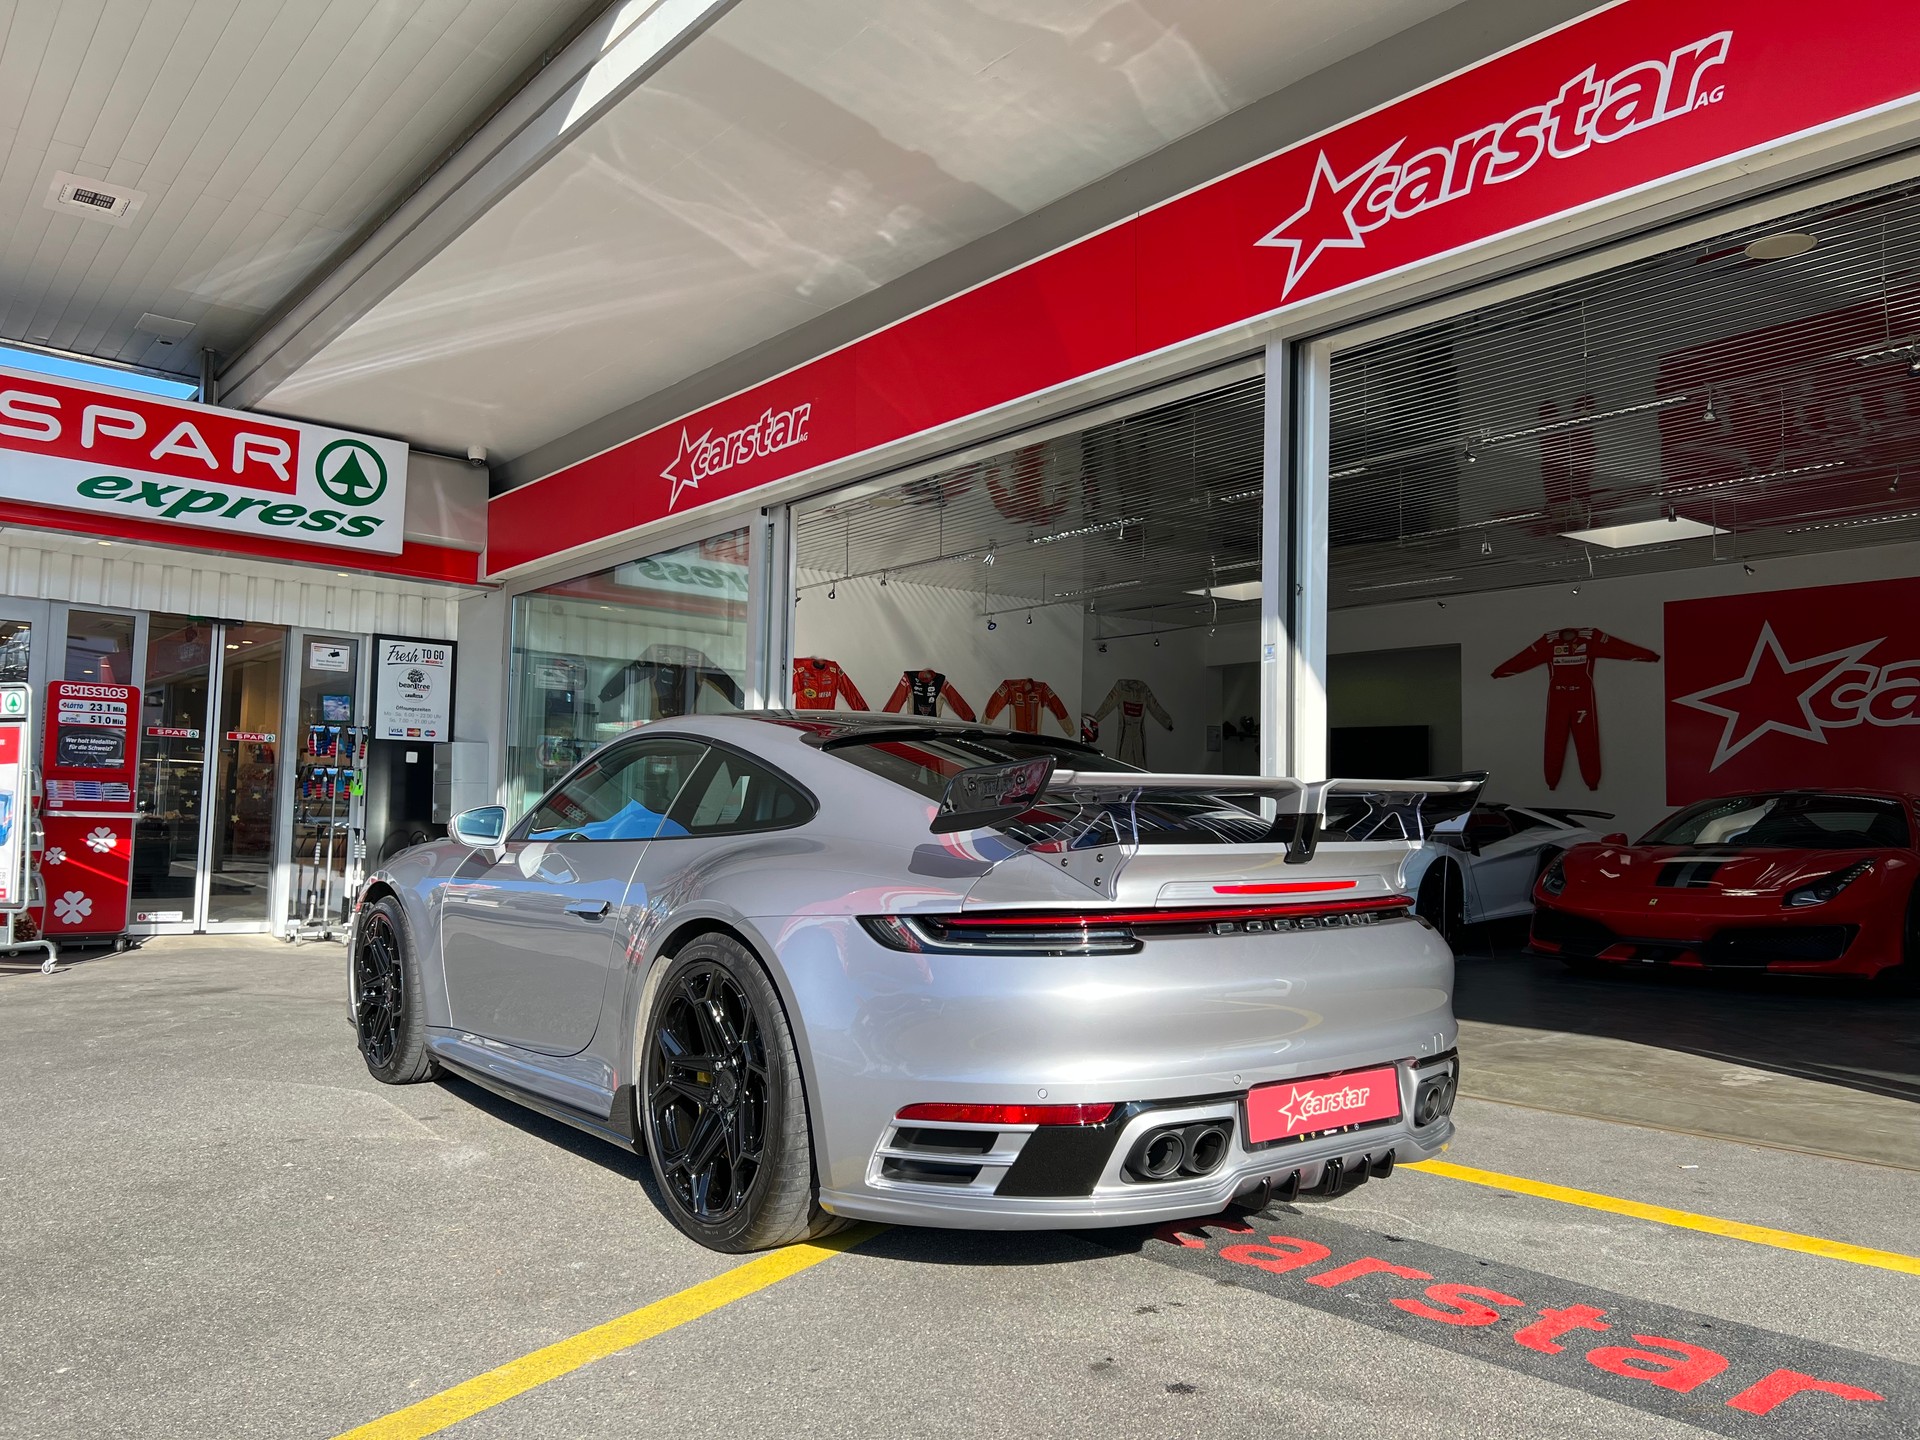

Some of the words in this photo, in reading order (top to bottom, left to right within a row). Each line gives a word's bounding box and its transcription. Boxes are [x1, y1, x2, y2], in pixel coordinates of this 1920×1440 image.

[1344, 30, 1734, 235] carstar
[1693, 84, 1726, 111] AG
[0, 390, 292, 482] SPAR
[692, 402, 812, 480] carstar
[799, 432, 809, 443] AG
[77, 475, 385, 538] express
[387, 645, 419, 663] Fresh
[422, 649, 432, 660] TO
[434, 650, 444, 660] GO
[60, 685, 127, 698] SWISSLOS
[90, 703, 111, 713] 23,1
[1577, 710, 1587, 723] 7
[90, 715, 111, 725] 51,0
[157, 728, 188, 737] SPAR
[235, 733, 265, 741] SPAR
[1216, 912, 1380, 936] PORSCHE
[1302, 1085, 1370, 1117] carstar
